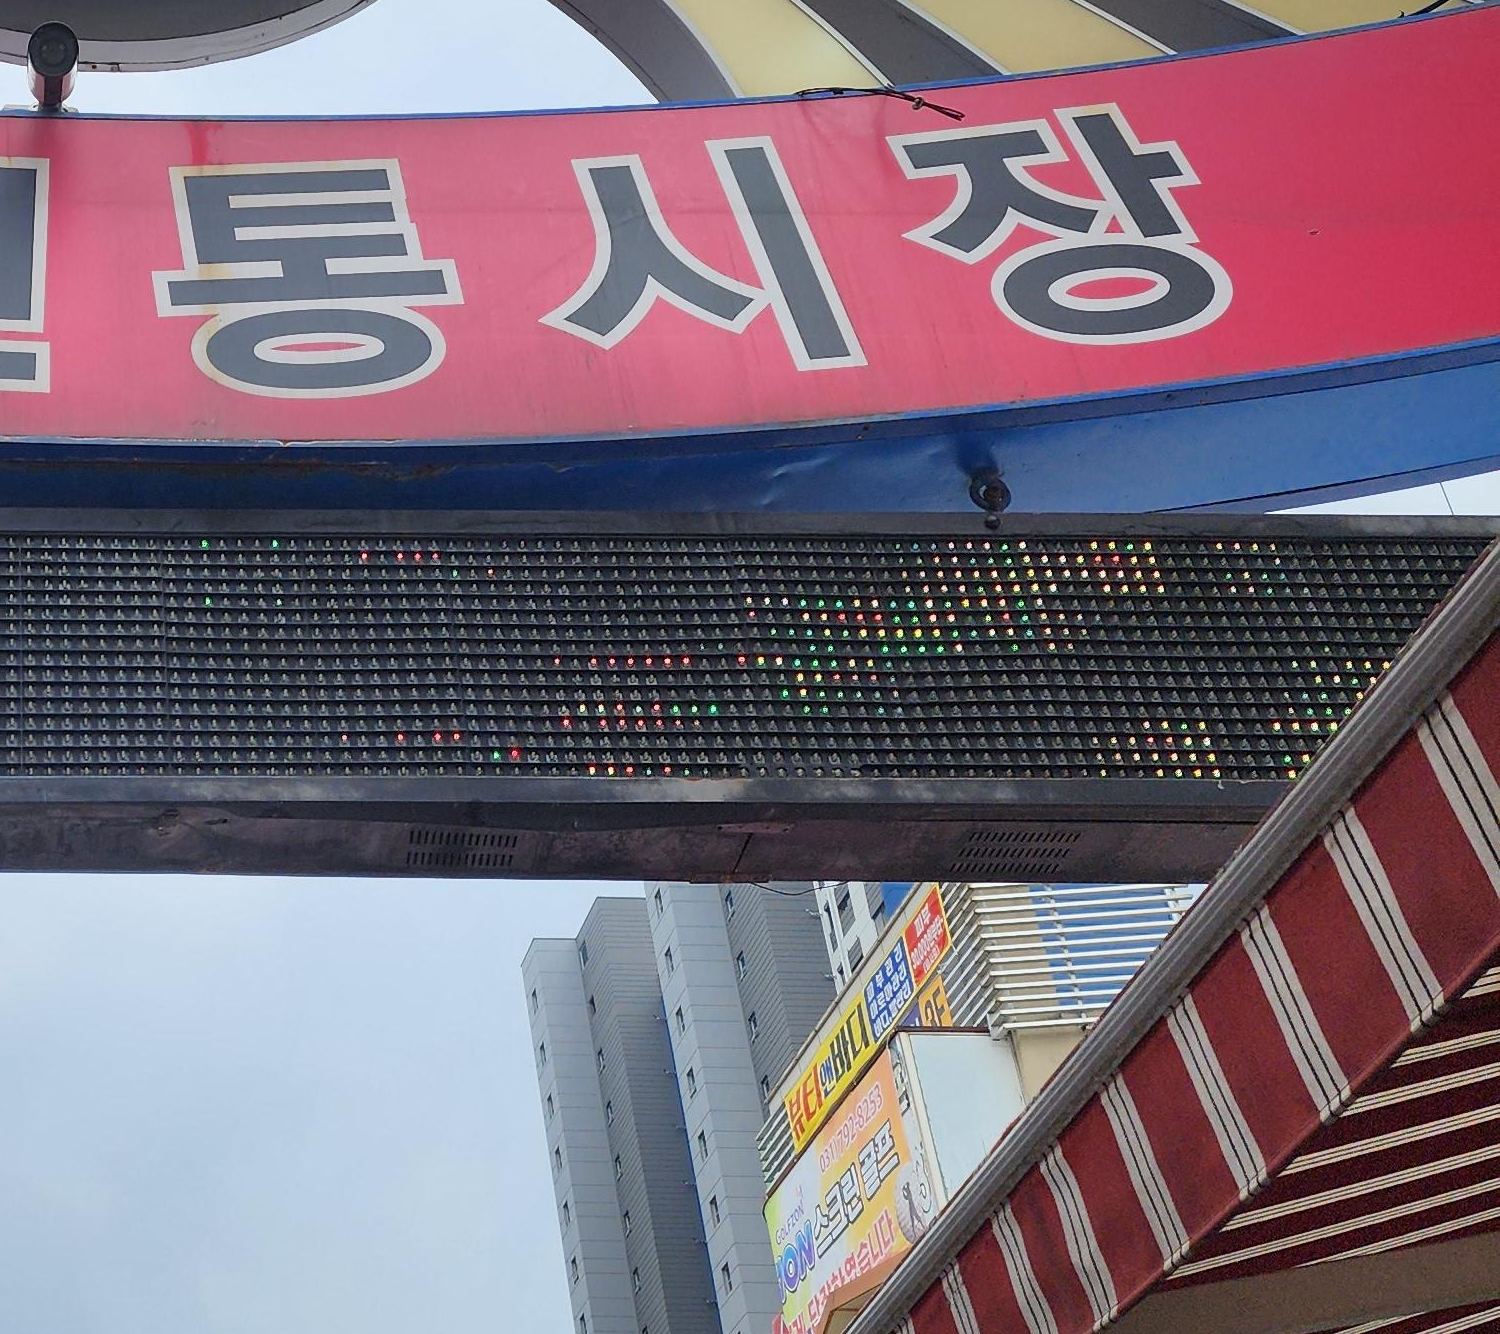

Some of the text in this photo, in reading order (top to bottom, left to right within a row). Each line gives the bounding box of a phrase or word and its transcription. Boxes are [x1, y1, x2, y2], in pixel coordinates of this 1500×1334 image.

[787, 1001, 871, 1142] 뷰티앤바디
[814, 1162, 865, 1259] 스크린
[857, 1118, 901, 1201] 골프
